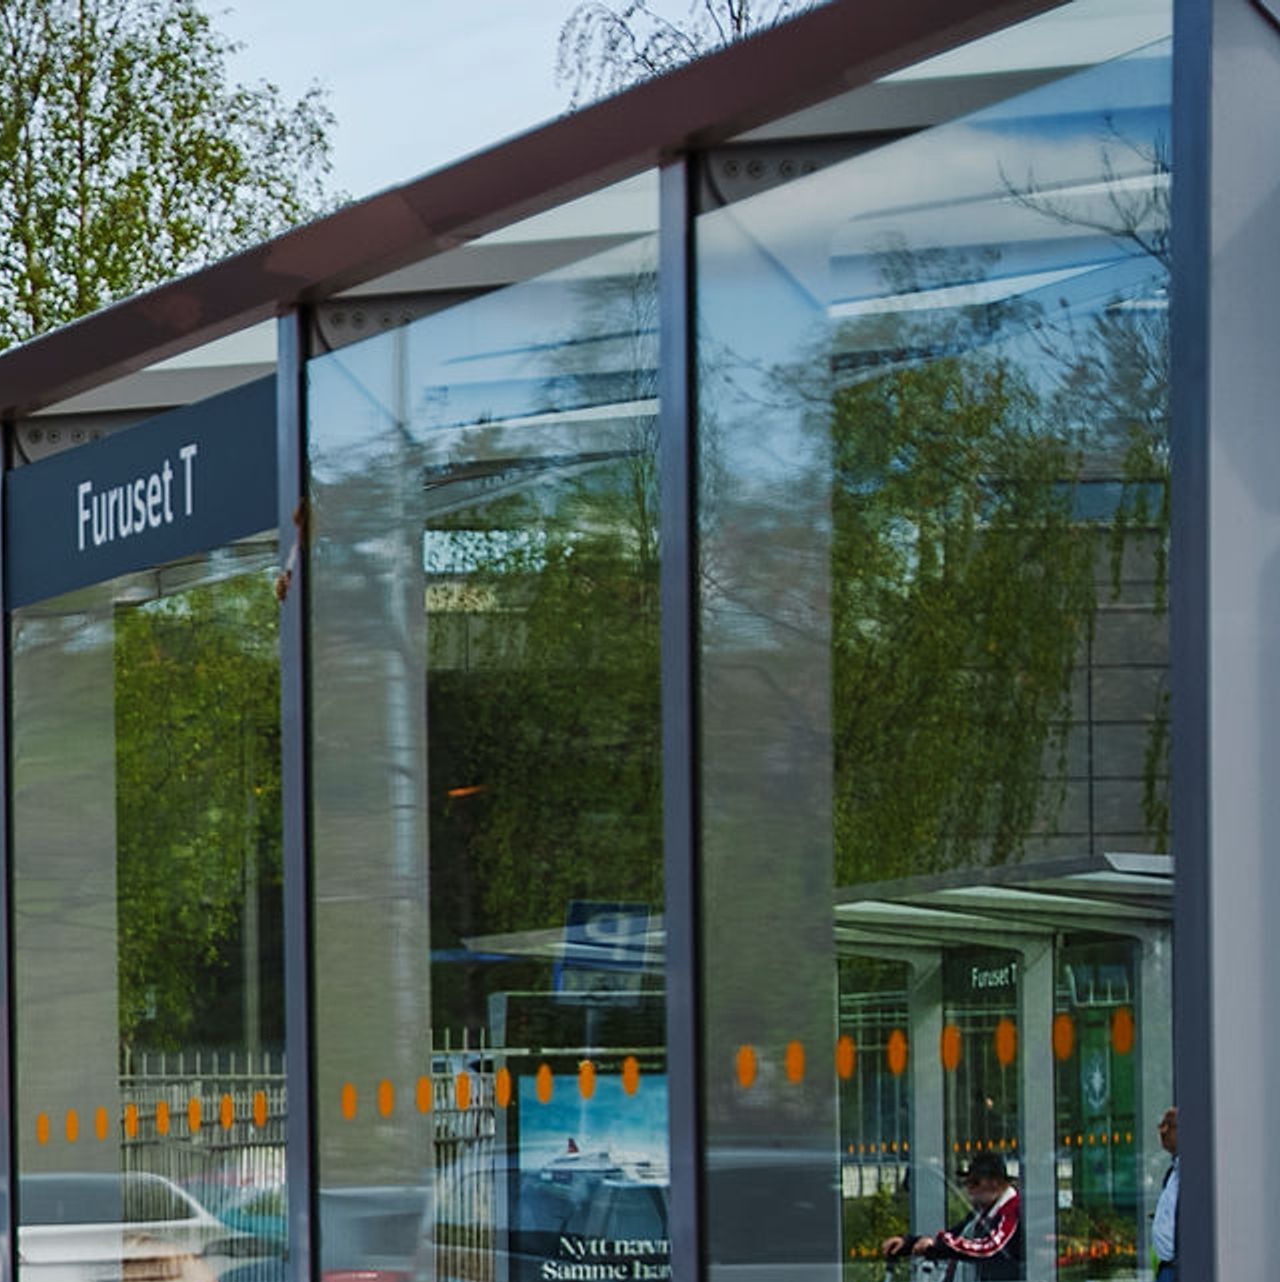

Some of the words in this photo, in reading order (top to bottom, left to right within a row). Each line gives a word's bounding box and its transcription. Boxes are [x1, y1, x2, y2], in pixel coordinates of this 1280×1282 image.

[77, 458, 174, 551] Furuset
[179, 443, 198, 516] T
[559, 1235, 607, 1261] Nytt
[542, 1259, 629, 1281] Samme
